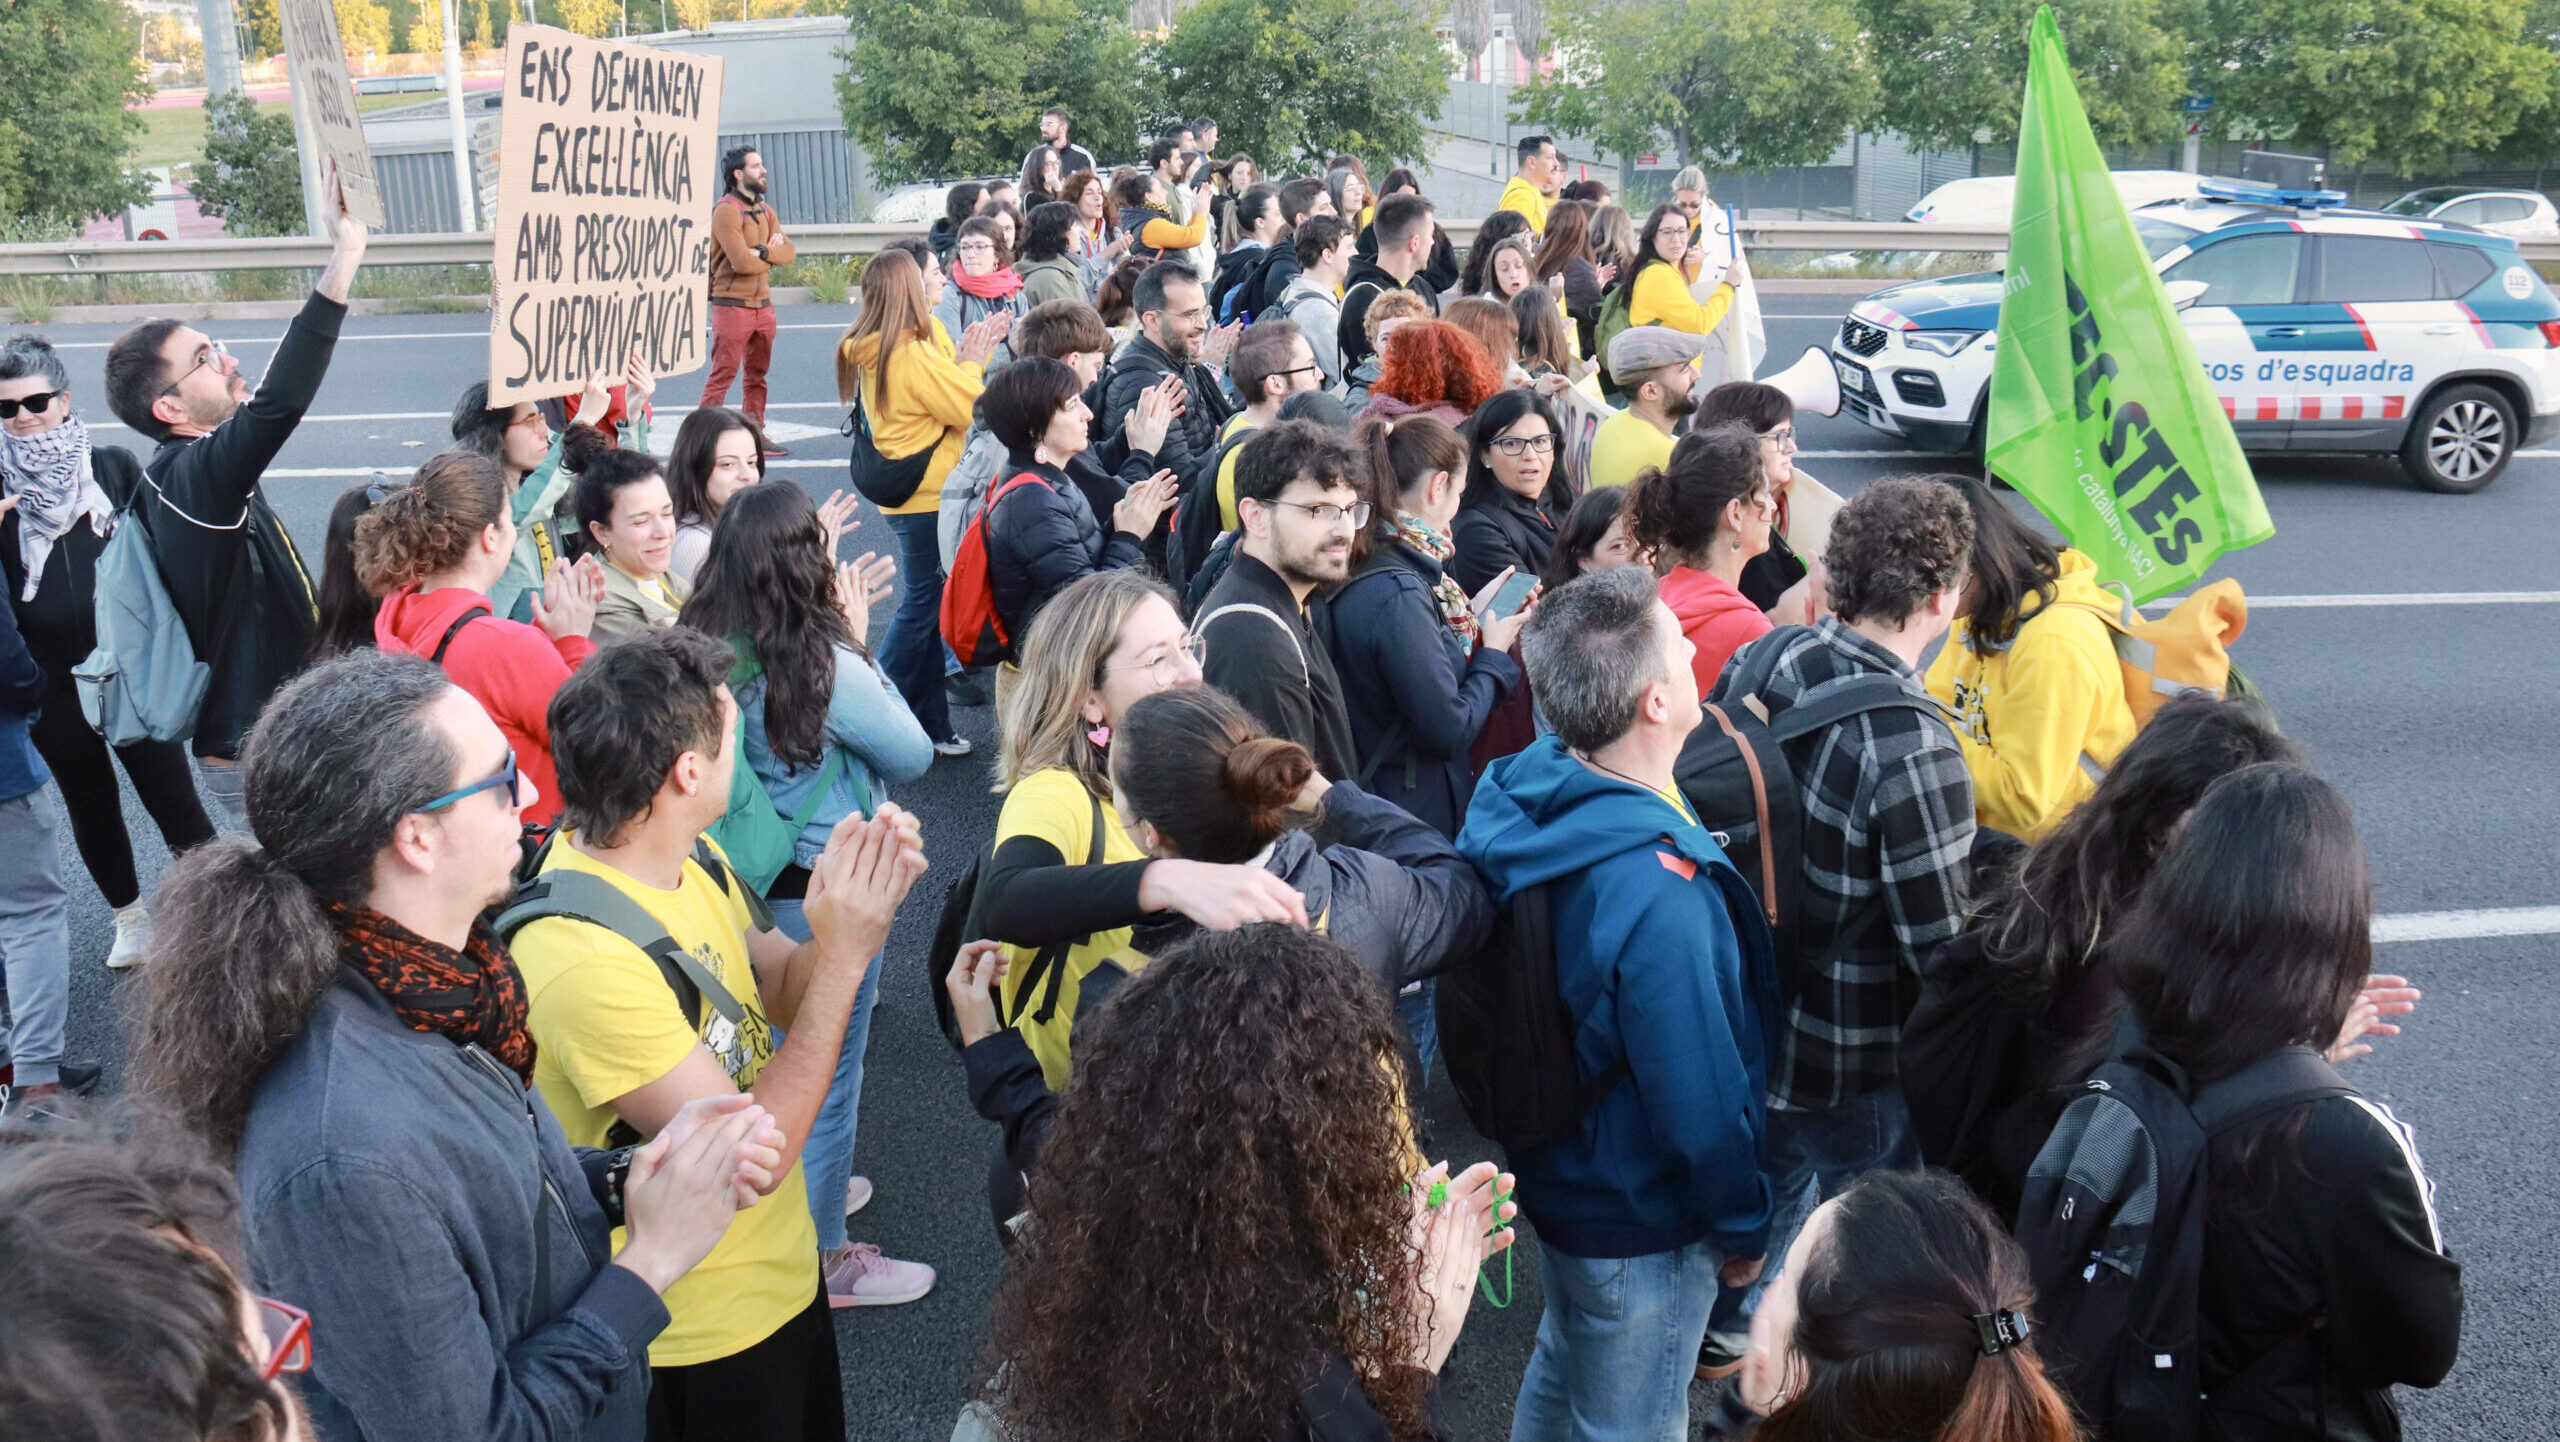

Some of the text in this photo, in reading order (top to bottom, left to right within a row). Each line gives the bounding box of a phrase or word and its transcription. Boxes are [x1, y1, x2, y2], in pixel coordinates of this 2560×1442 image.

[520, 41, 704, 121] ENS DEMANEN
[513, 211, 710, 285] AMB PRESSUPOST DE
[2257, 358, 2414, 387] d'esquadra
